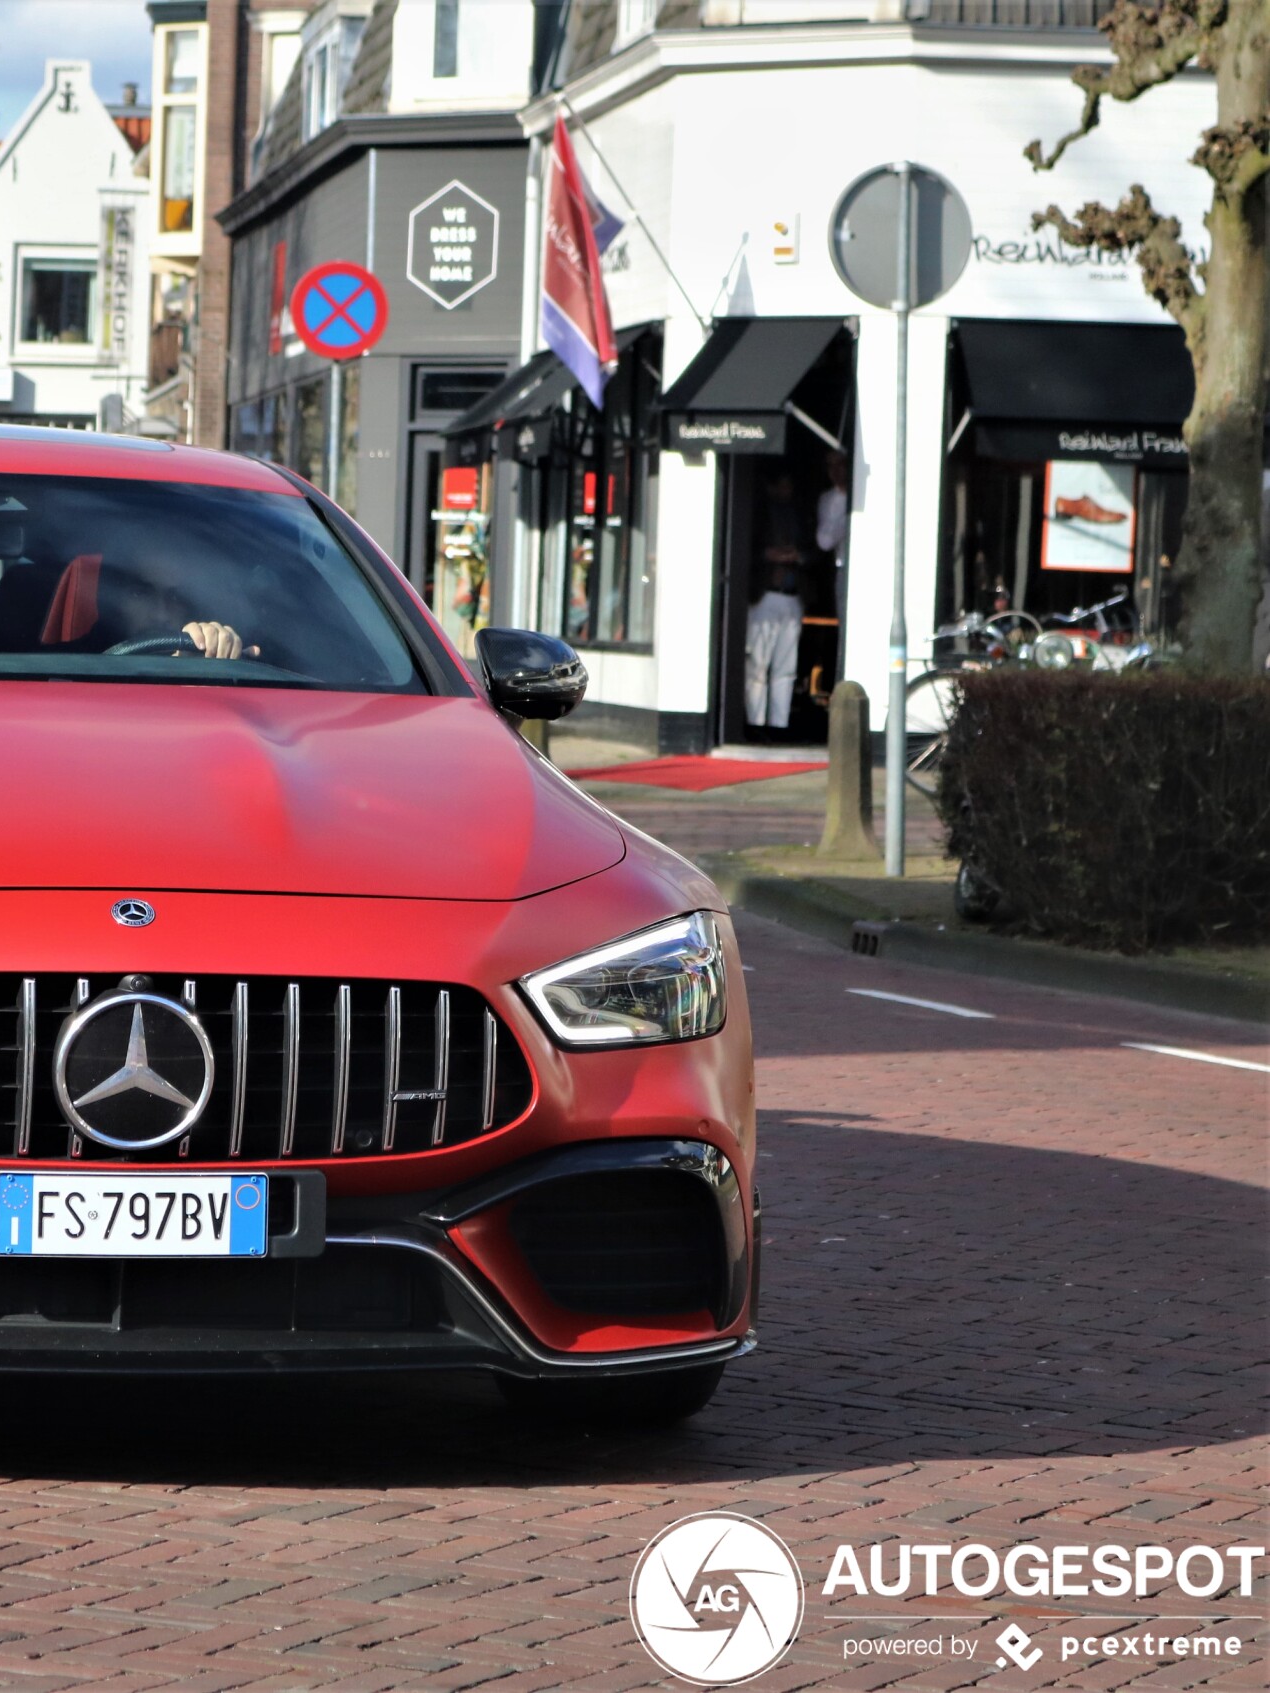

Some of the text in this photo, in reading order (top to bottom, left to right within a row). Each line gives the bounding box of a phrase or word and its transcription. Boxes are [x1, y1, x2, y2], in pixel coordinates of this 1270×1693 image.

[442, 207, 467, 223] WE
[430, 227, 477, 243] DRESS
[433, 246, 472, 262] YOUR
[430, 265, 473, 282] HOME
[1142, 431, 1190, 453] Fran
[410, 1092, 447, 1101] AMG
